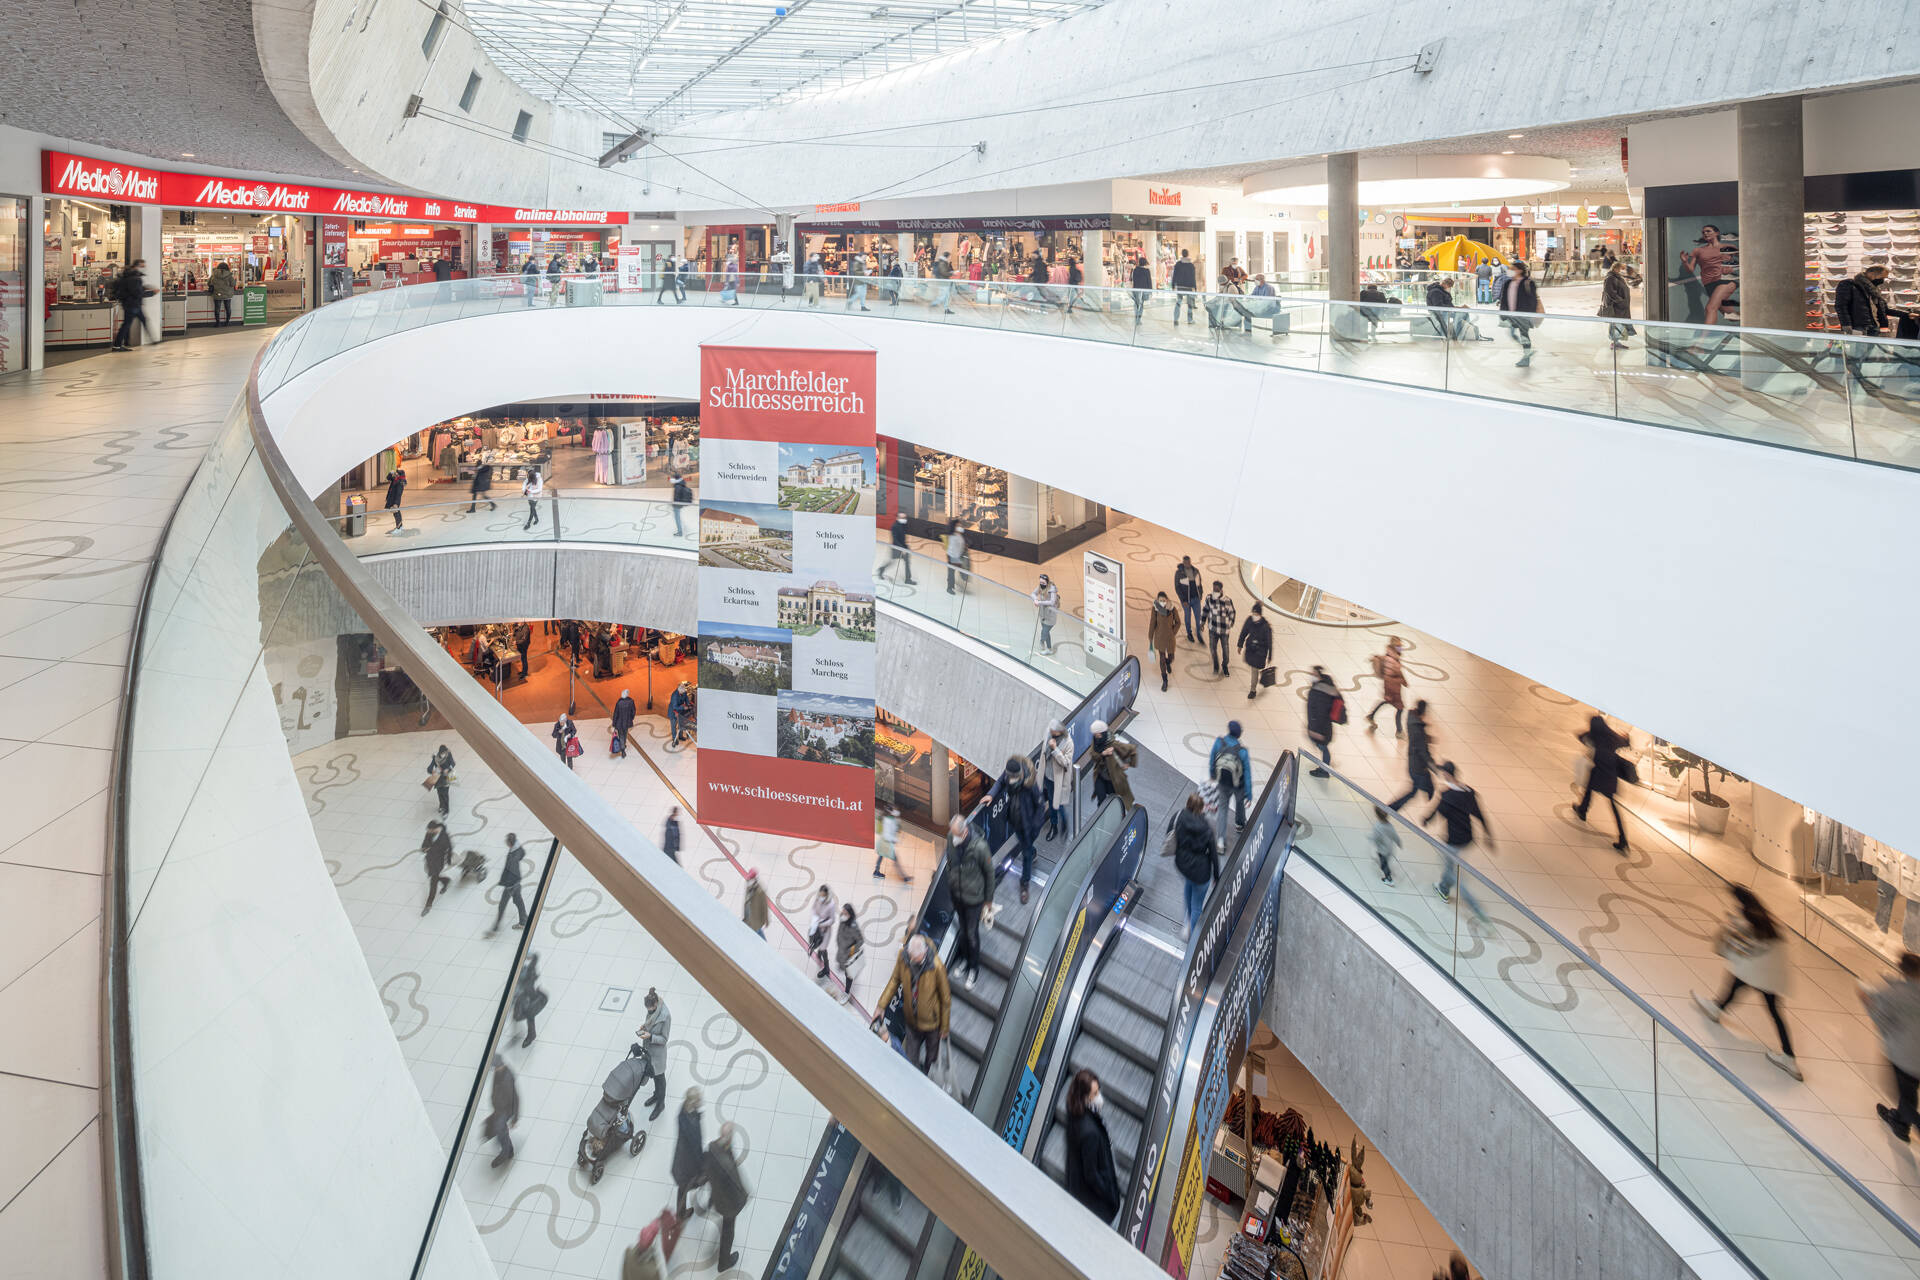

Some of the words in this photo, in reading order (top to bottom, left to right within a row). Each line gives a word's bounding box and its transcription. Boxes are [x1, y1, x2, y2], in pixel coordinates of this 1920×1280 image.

[425, 203, 440, 216] Info
[454, 205, 477, 219] Service
[515, 209, 552, 221] Online
[553, 210, 608, 223] Abholung
[725, 368, 849, 394] Marchfelder
[728, 462, 756, 471] Schloss
[717, 472, 767, 482] Niederweiden
[815, 531, 845, 540] Schloss
[823, 542, 837, 550] Hof
[727, 586, 755, 596] Schloss
[723, 596, 760, 606] Eckartsau
[815, 657, 844, 668] Schloss
[811, 668, 849, 681] Marchegg
[727, 711, 755, 721] Schloss
[732, 722, 749, 731] Orth
[708, 782, 864, 812] www.schloesserreich.at
[1161, 994, 1191, 1114] JEDEN
[1190, 893, 1231, 995] SONNTAG
[1231, 879, 1242, 906] AB
[1250, 822, 1265, 862] UHR
[777, 1212, 808, 1273] DAS
